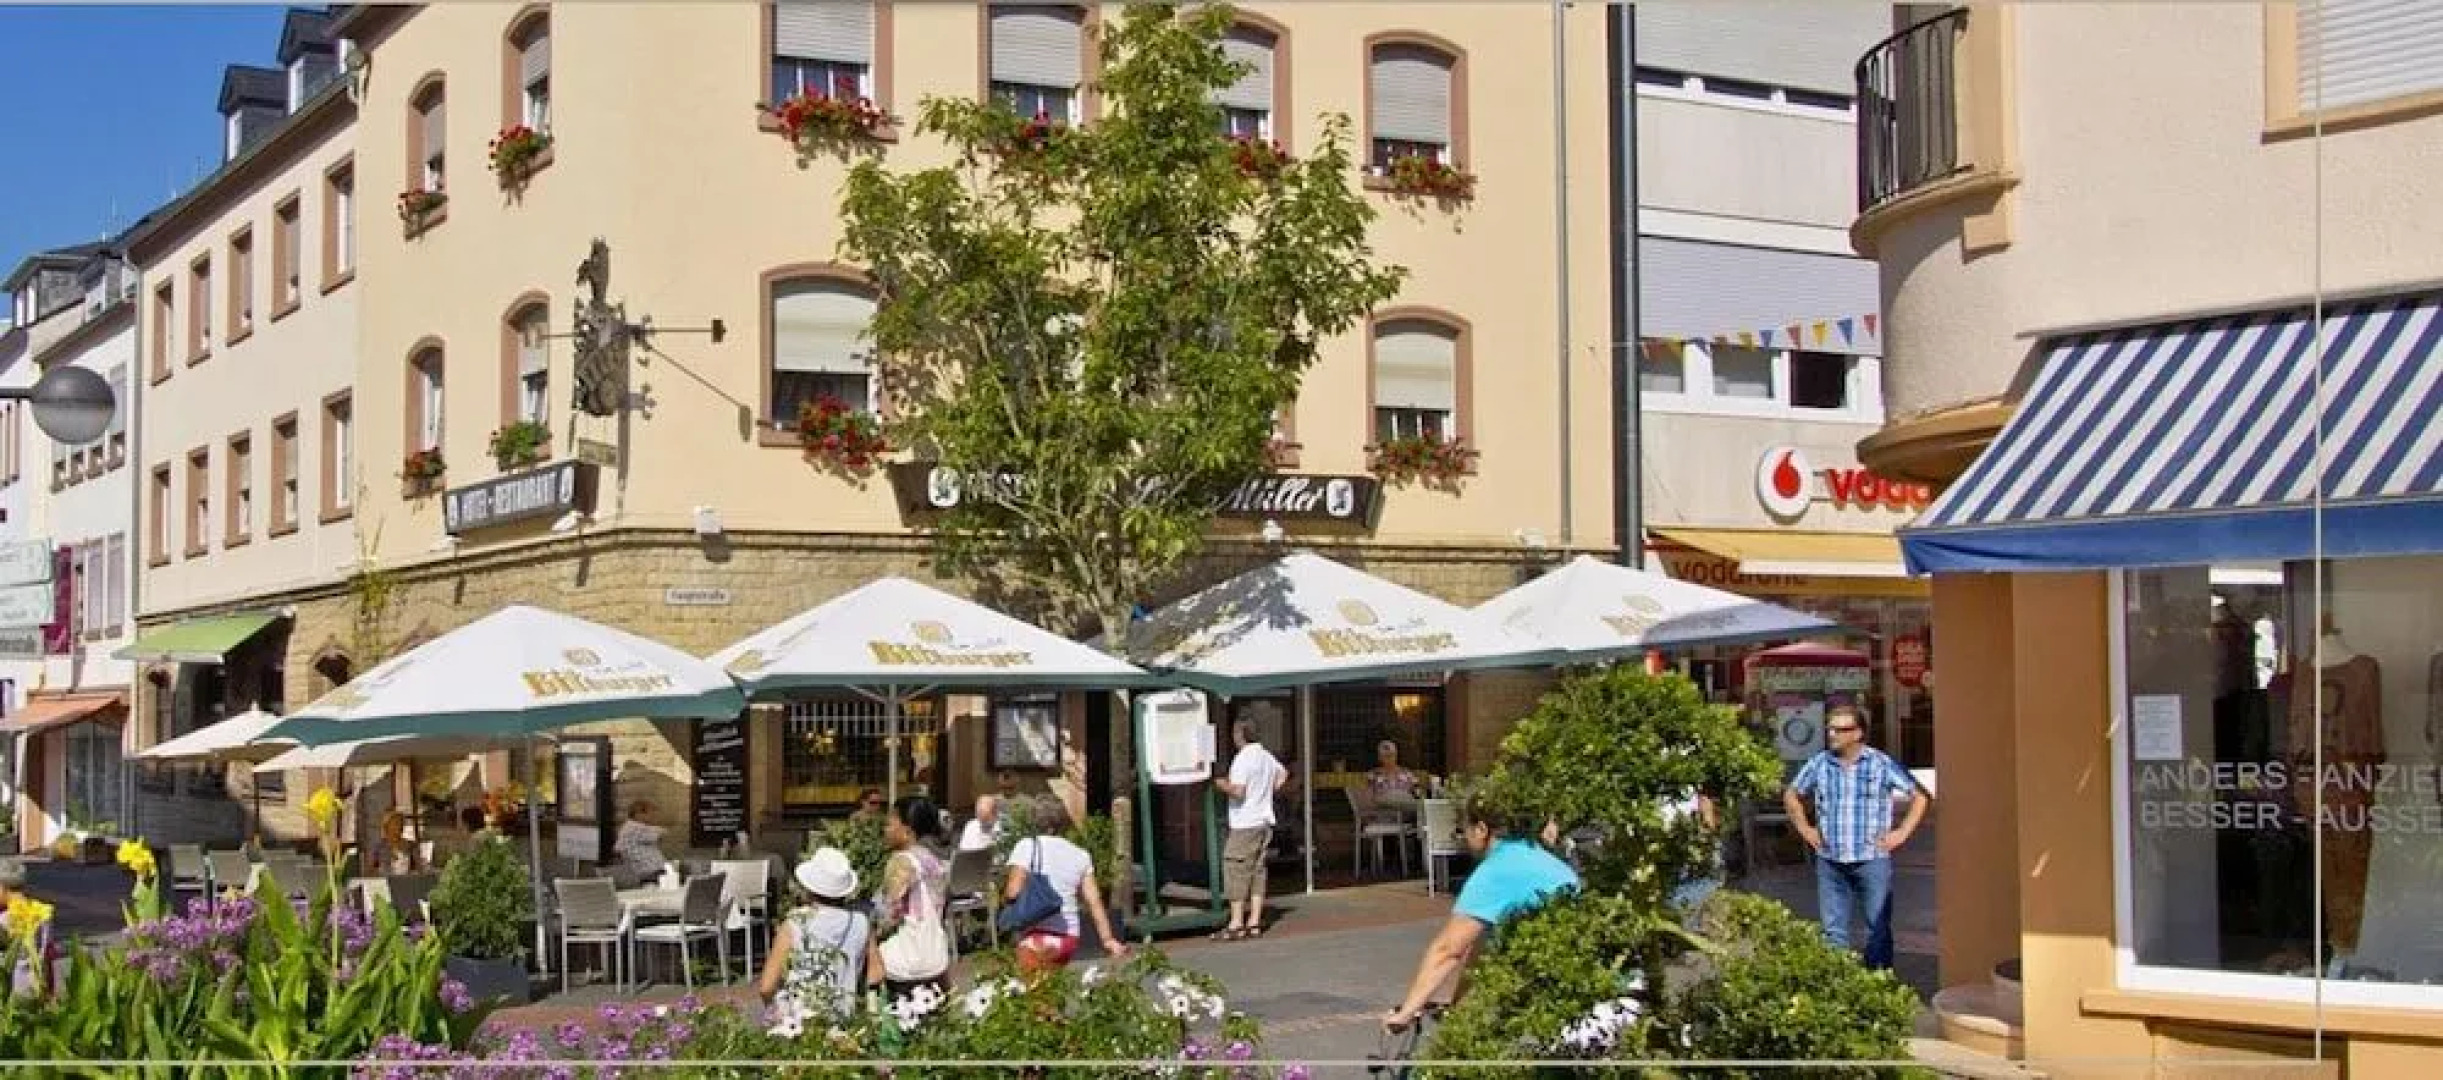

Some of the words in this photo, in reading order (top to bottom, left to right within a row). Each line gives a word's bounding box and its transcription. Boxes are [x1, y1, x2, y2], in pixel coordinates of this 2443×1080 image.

[2141, 762, 2288, 792] ANDERS
[2319, 763, 2443, 793] ANZIE
[2142, 802, 2283, 830] BESSER
